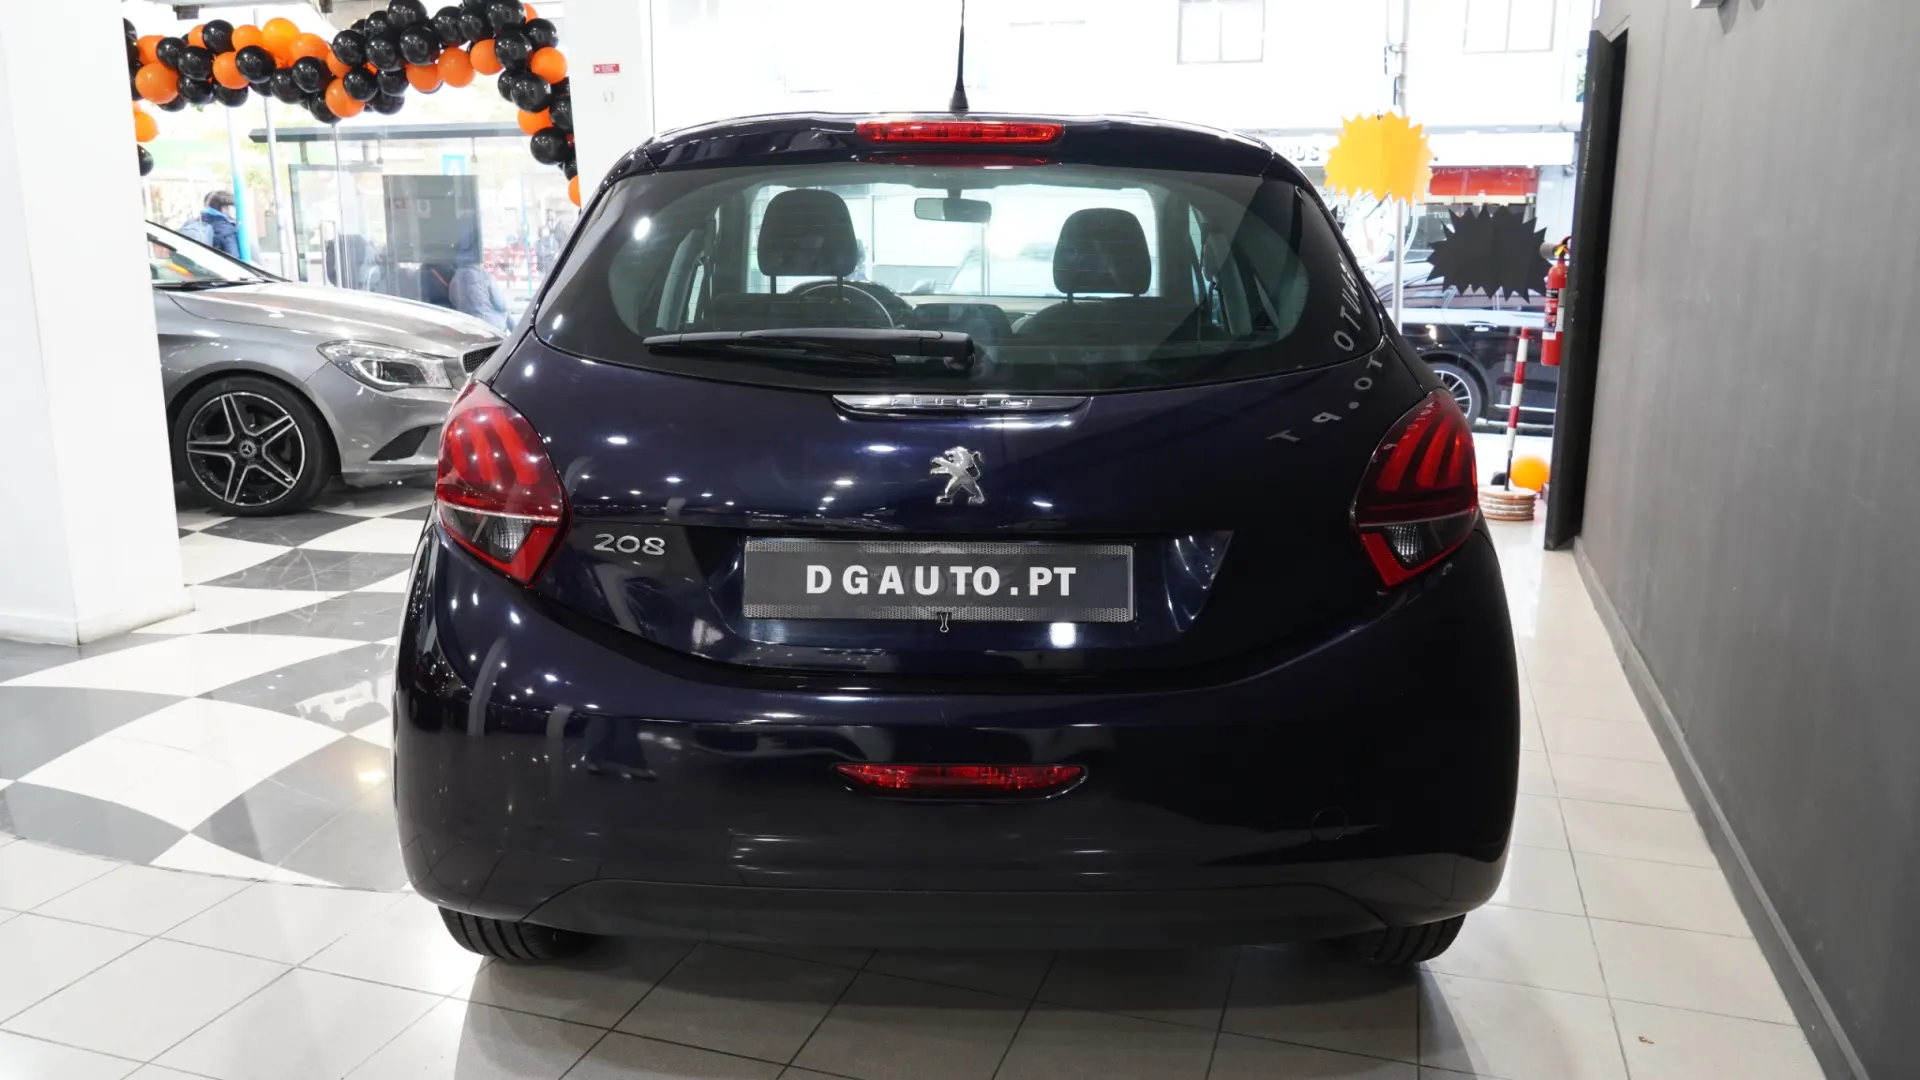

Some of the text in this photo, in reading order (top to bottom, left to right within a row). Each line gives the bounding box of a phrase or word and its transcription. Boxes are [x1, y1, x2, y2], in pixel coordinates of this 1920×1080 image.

[888, 397, 1034, 408] PEUGEOT
[593, 533, 666, 556] 208
[805, 564, 1077, 597] DGAUTO.PT
